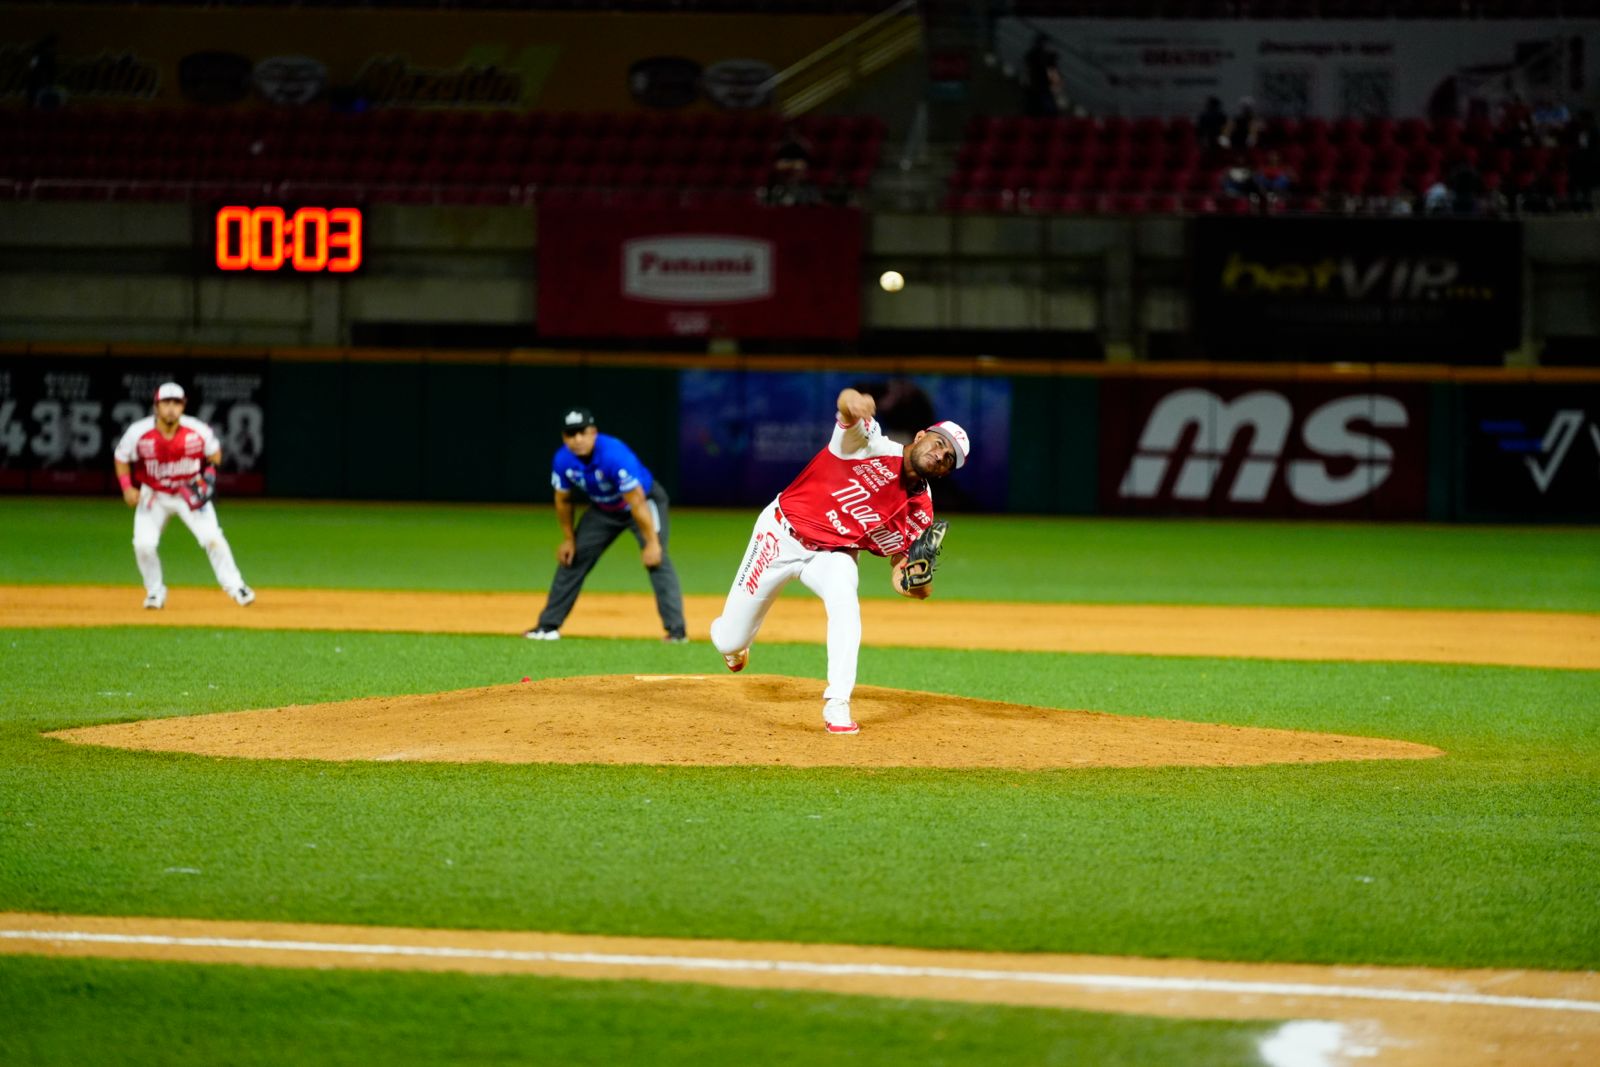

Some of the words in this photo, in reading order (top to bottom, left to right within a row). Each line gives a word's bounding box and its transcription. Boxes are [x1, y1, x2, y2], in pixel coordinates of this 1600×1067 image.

[217, 206, 362, 272] 00:03
[870, 458, 898, 480] telcel
[1116, 386, 1410, 507] ms
